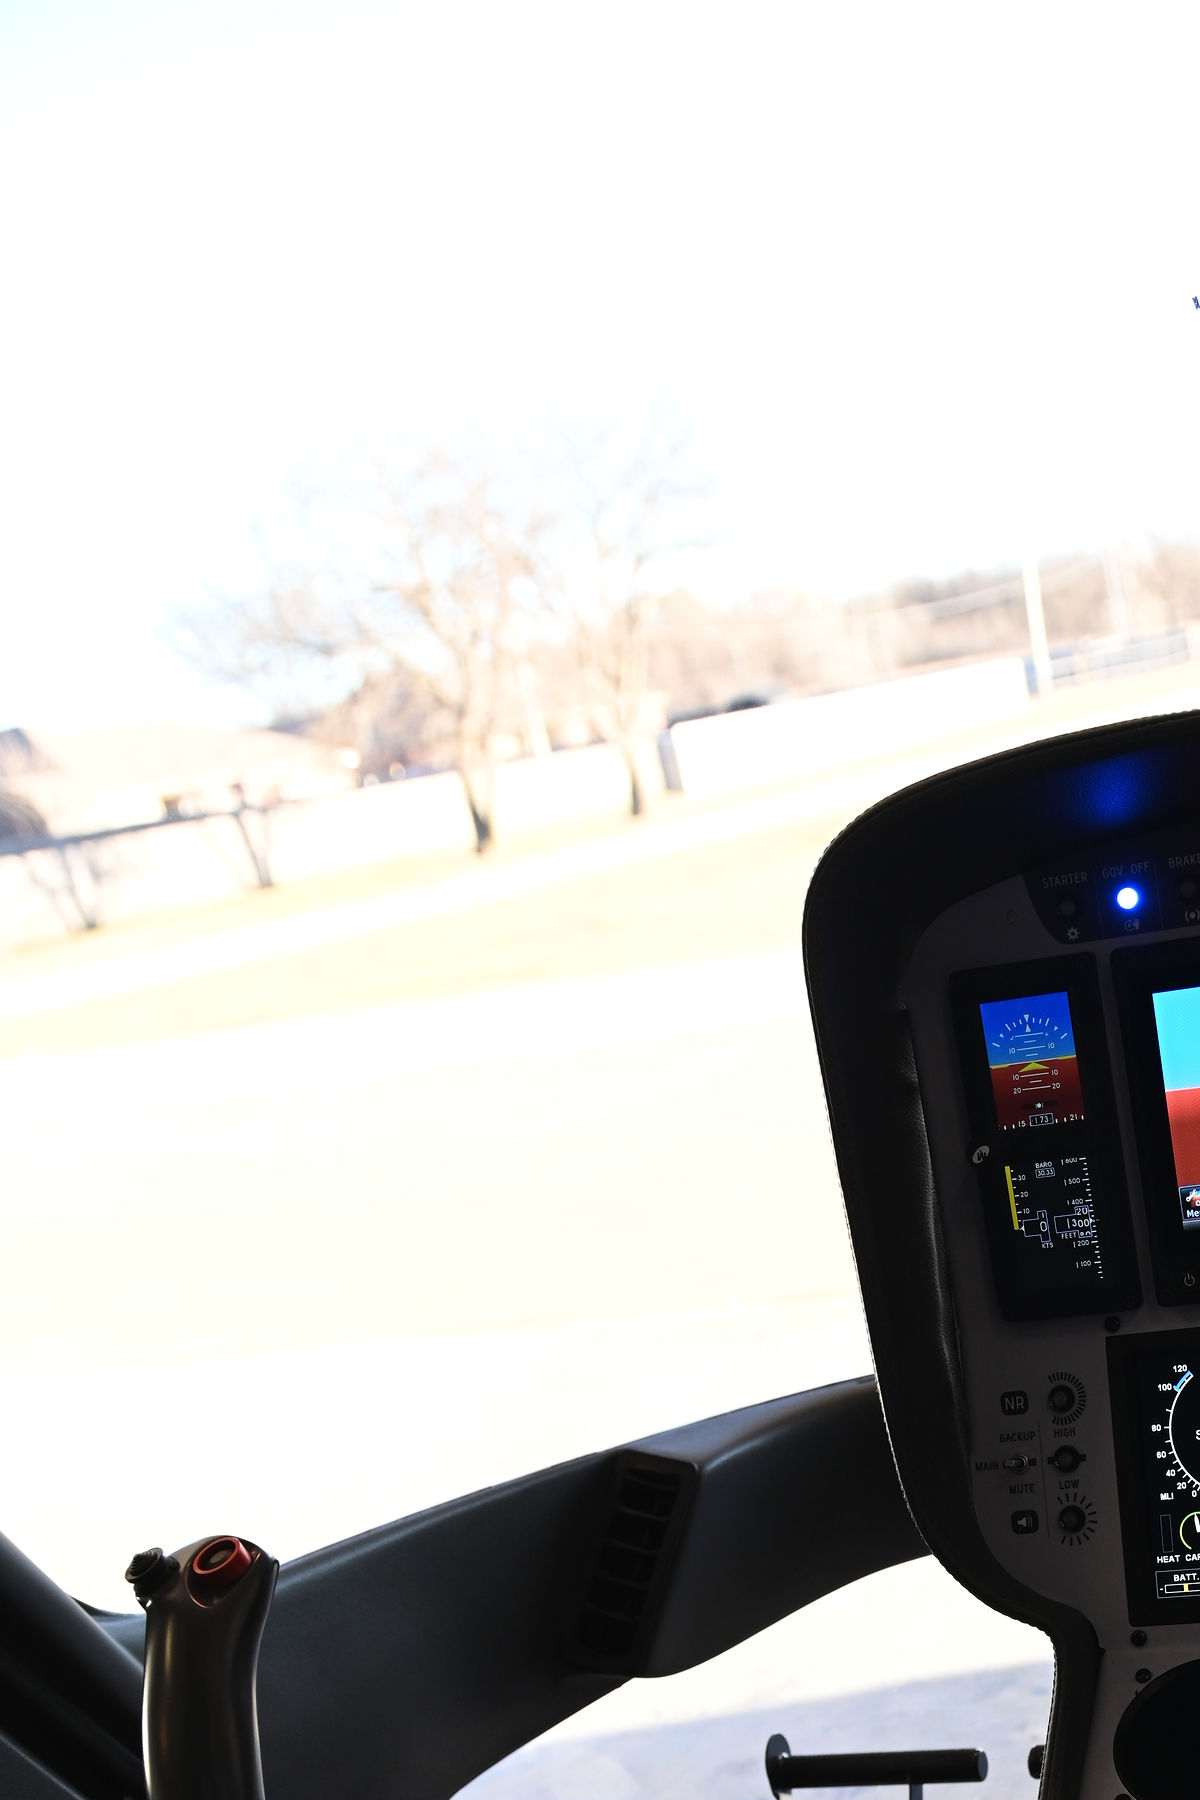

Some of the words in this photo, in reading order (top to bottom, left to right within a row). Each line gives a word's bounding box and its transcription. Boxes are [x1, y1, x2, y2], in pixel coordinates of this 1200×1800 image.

[1102, 863, 1128, 880] GOV.
[1131, 861, 1151, 875] OFF
[1041, 871, 1088, 889] STARTER
[1035, 1161, 1052, 1169] BARO
[1005, 1396, 1025, 1410] NR
[1000, 1431, 1036, 1443] BACKUP
[1054, 1428, 1076, 1438] HIGH
[975, 1461, 999, 1471] MAIN
[1009, 1483, 1035, 1494] MUTE
[1060, 1480, 1079, 1490] LOW
[1157, 1555, 1180, 1564] HEAT
[1173, 1573, 1199, 1581] BATT.
